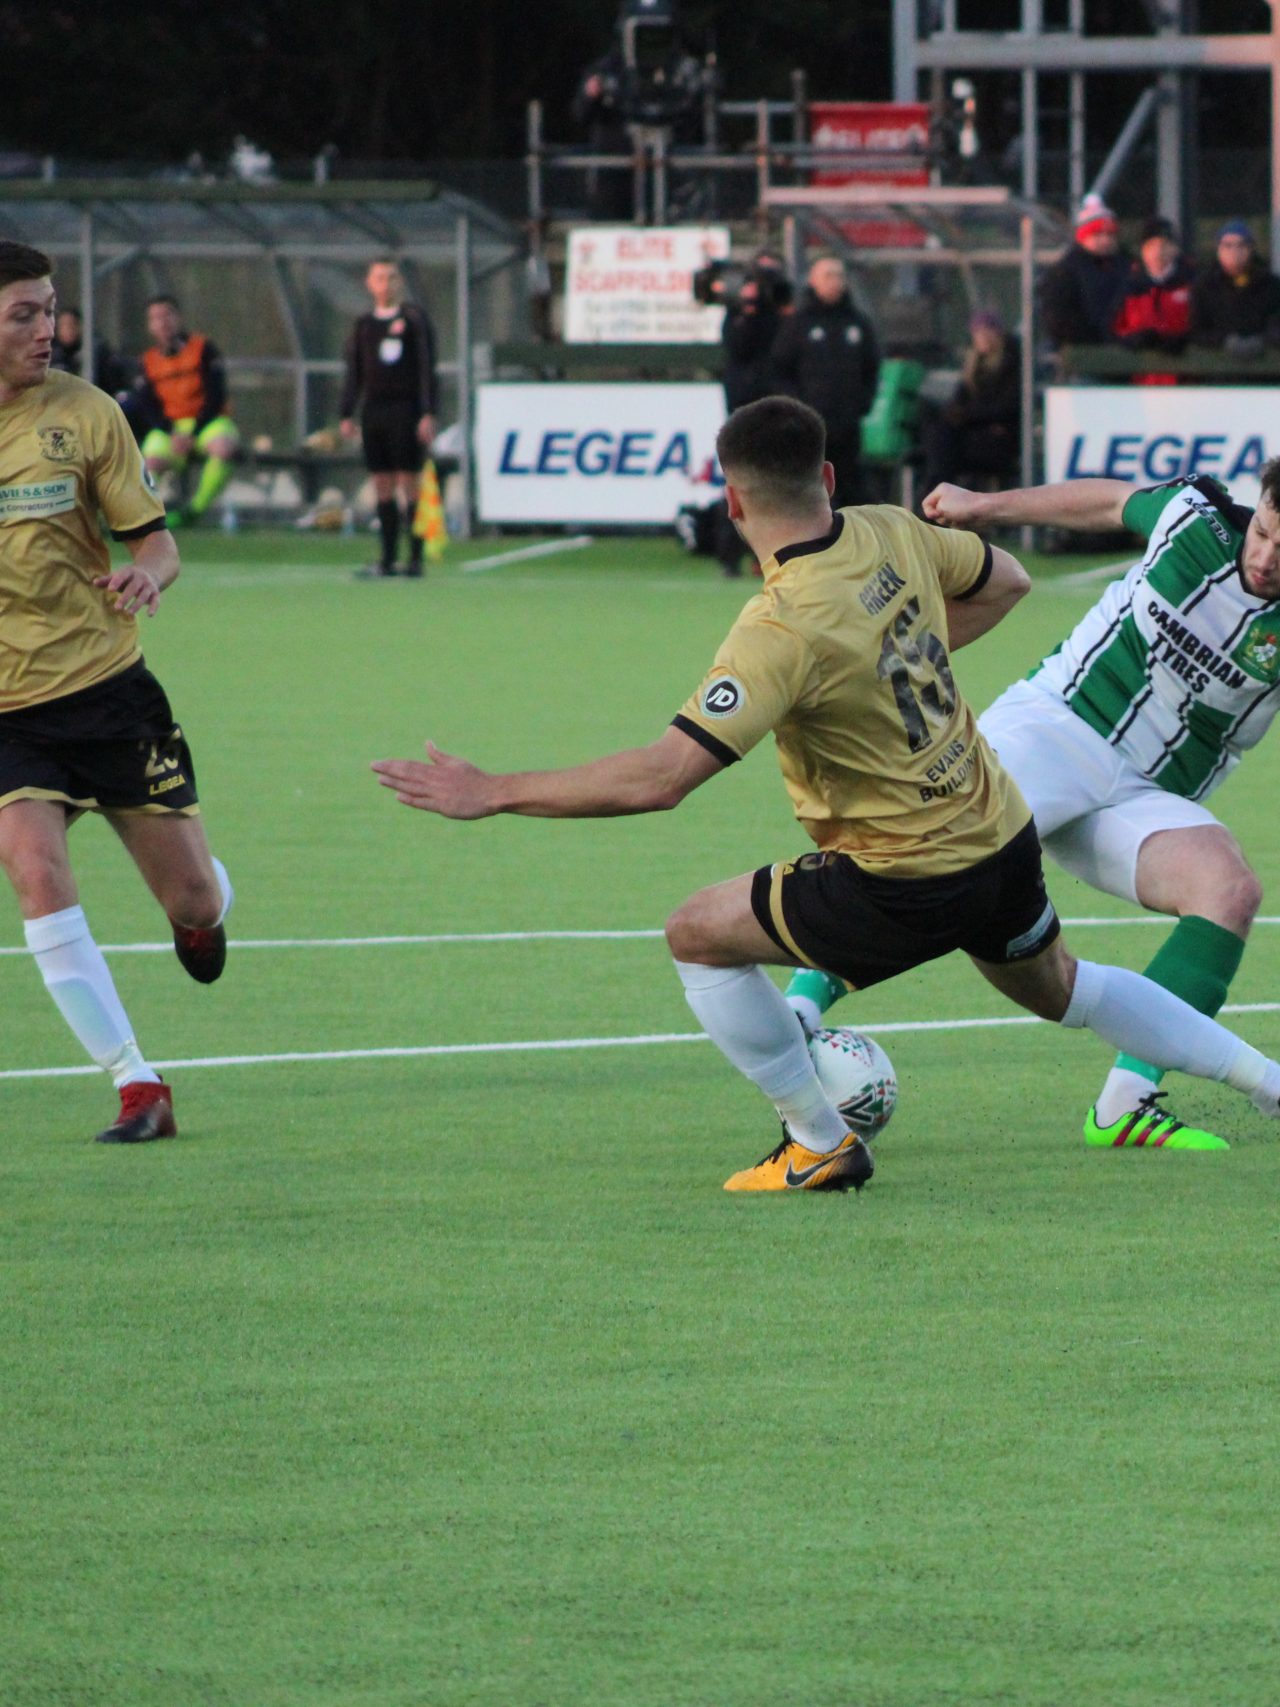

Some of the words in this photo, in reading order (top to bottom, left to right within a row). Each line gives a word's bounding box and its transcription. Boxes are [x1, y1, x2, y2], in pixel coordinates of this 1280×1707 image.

[498, 431, 690, 477] LEGEA
[1065, 432, 1267, 482] LEGEA
[43, 483, 67, 496] SON
[859, 562, 907, 616] GREEN
[1148, 601, 1248, 689] CAMBRIAN
[1149, 631, 1210, 693] TYRES
[706, 686, 736, 707] JD
[148, 773, 186, 795] LEGEA
[926, 739, 965, 784] EVANS
